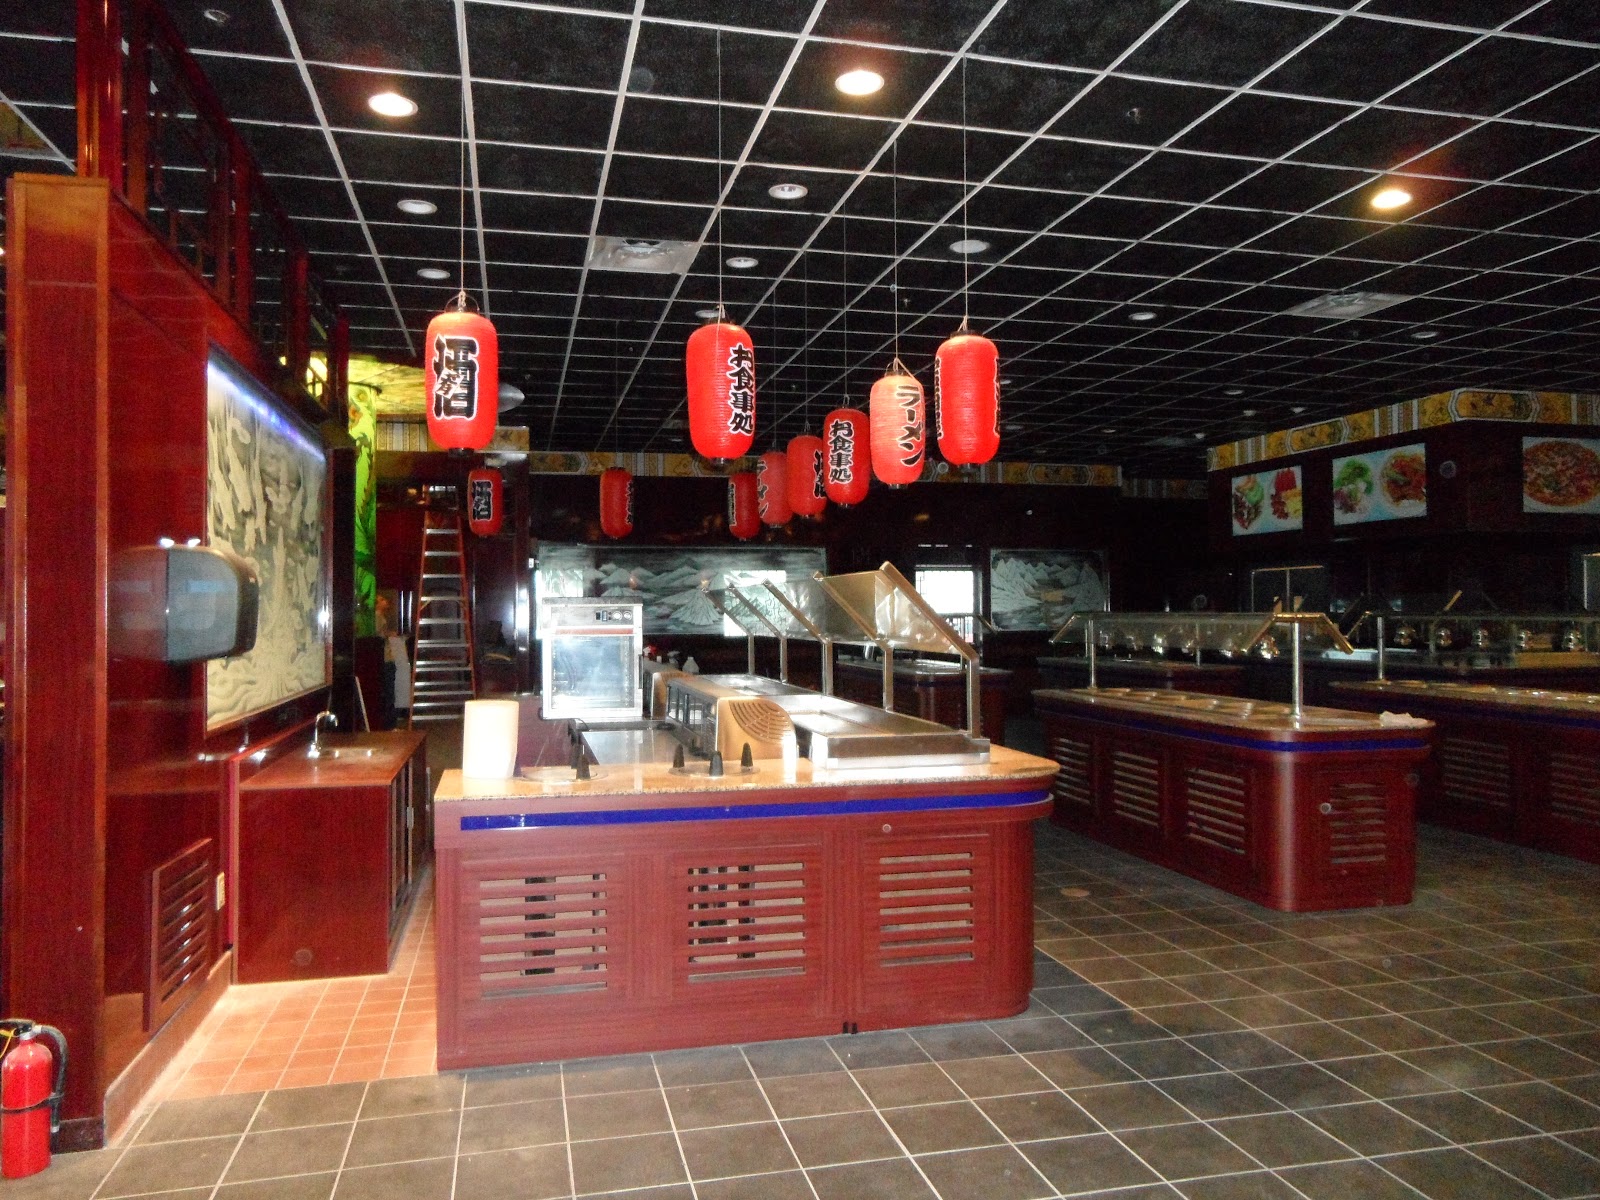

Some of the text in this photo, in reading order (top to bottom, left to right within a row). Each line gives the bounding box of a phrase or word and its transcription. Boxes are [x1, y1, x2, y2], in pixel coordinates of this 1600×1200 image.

[726, 342, 755, 436] お食事処
[896, 384, 924, 467] ラーメン
[828, 419, 854, 484] お食事処
